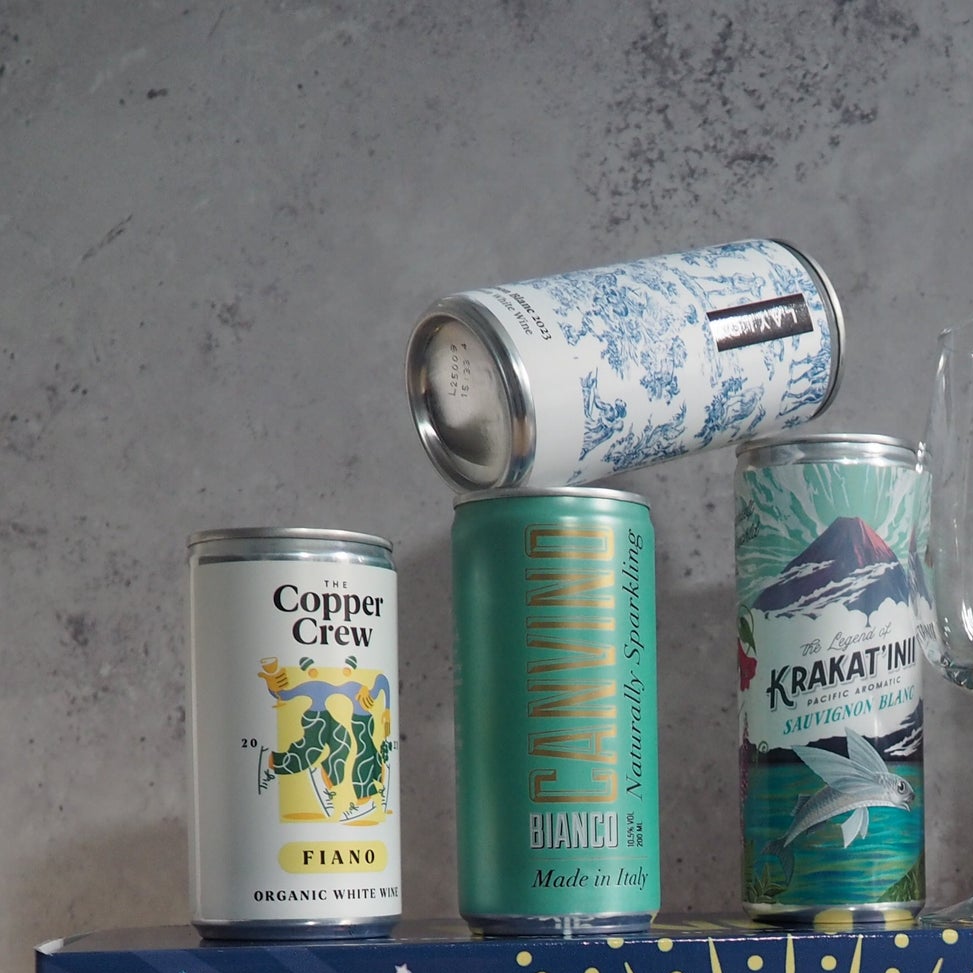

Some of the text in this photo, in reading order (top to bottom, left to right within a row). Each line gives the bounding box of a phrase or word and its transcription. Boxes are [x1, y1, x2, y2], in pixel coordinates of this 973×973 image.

[514, 311, 533, 335] Wine
[532, 314, 552, 341] 2023
[324, 580, 348, 589] THE
[273, 584, 384, 622] Copper
[292, 617, 373, 648] Crew
[524, 523, 619, 804] CANVINO
[621, 528, 646, 800] Naturally Sparkling
[807, 676, 902, 706] PACIFIC AROMATIC
[783, 686, 916, 735] SAUVIGNON BLANC
[241, 738, 258, 748] 20
[530, 810, 619, 850] BIANCO
[302, 849, 376, 865] FIANO
[531, 866, 648, 890] Made in Italy
[253, 886, 399, 902] ORGANIC WHITE WINE
